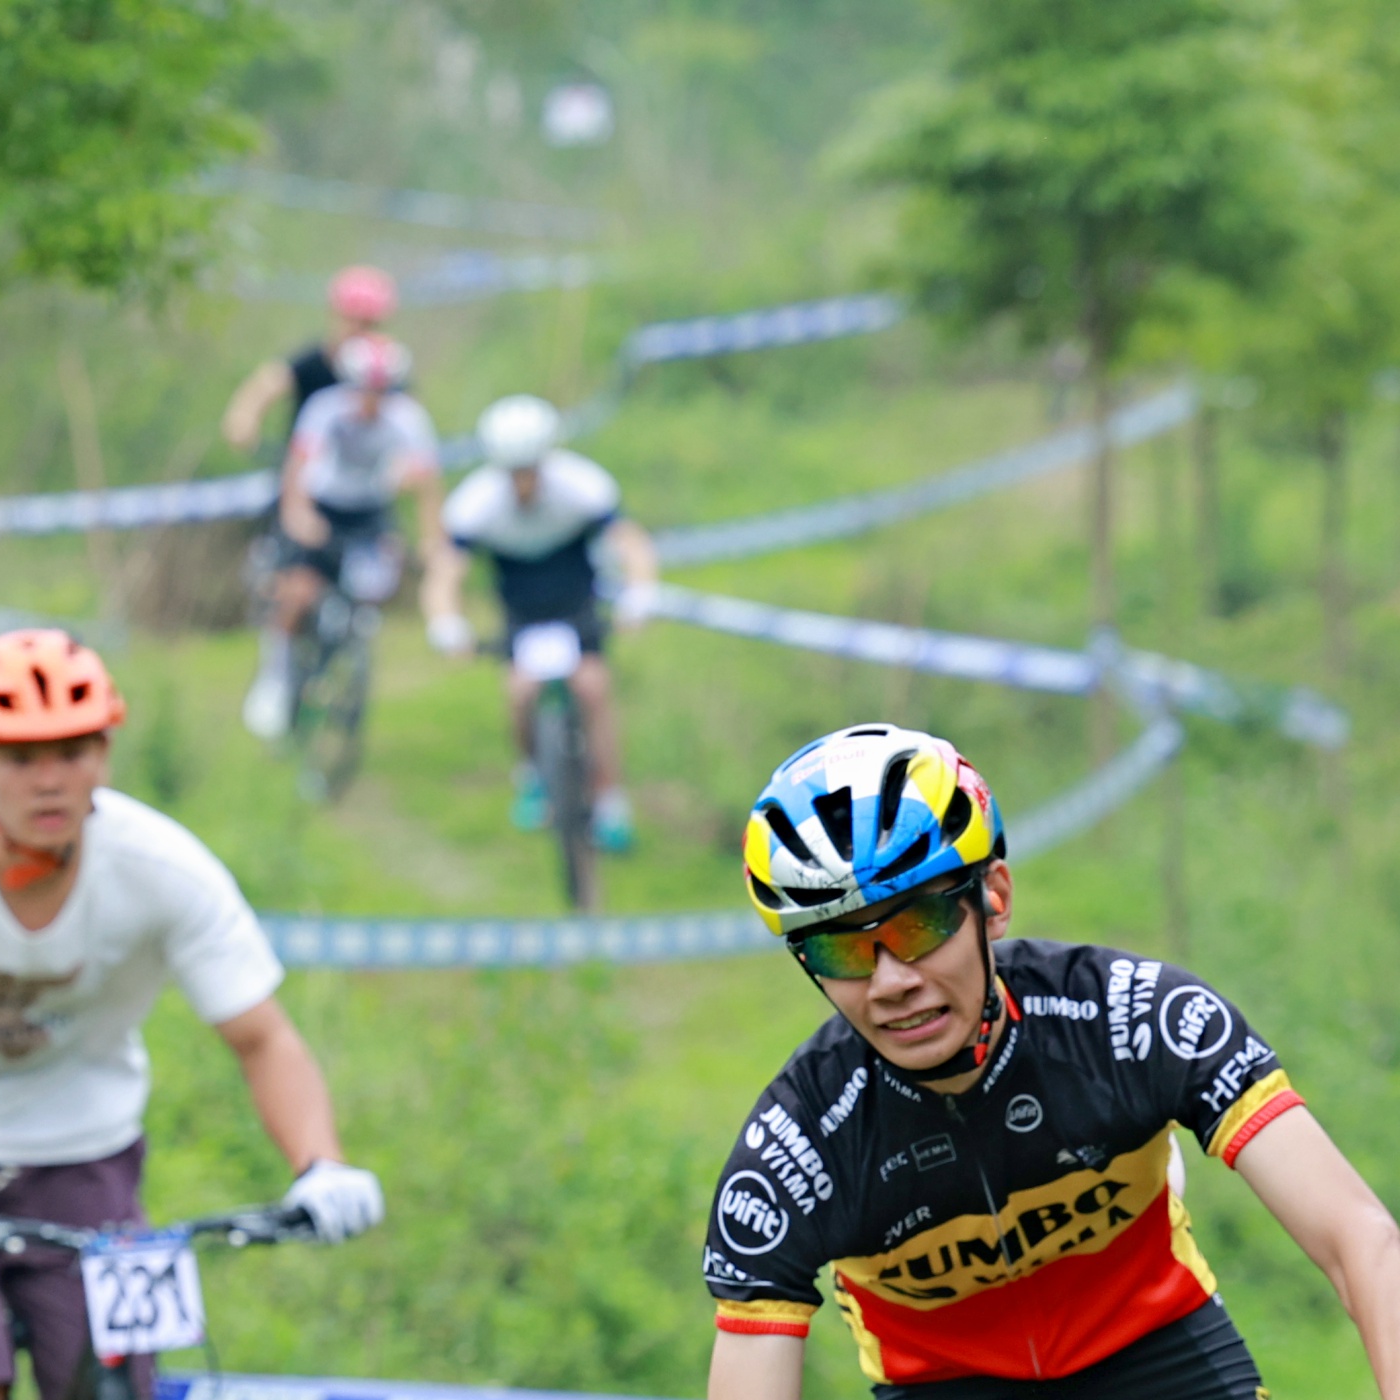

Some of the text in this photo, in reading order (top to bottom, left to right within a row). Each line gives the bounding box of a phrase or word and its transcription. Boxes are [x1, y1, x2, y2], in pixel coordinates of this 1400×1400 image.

[1107, 959, 1136, 1062] JUMBO
[759, 1103, 834, 1201] JUMBO
[760, 1141, 817, 1216] VISMA
